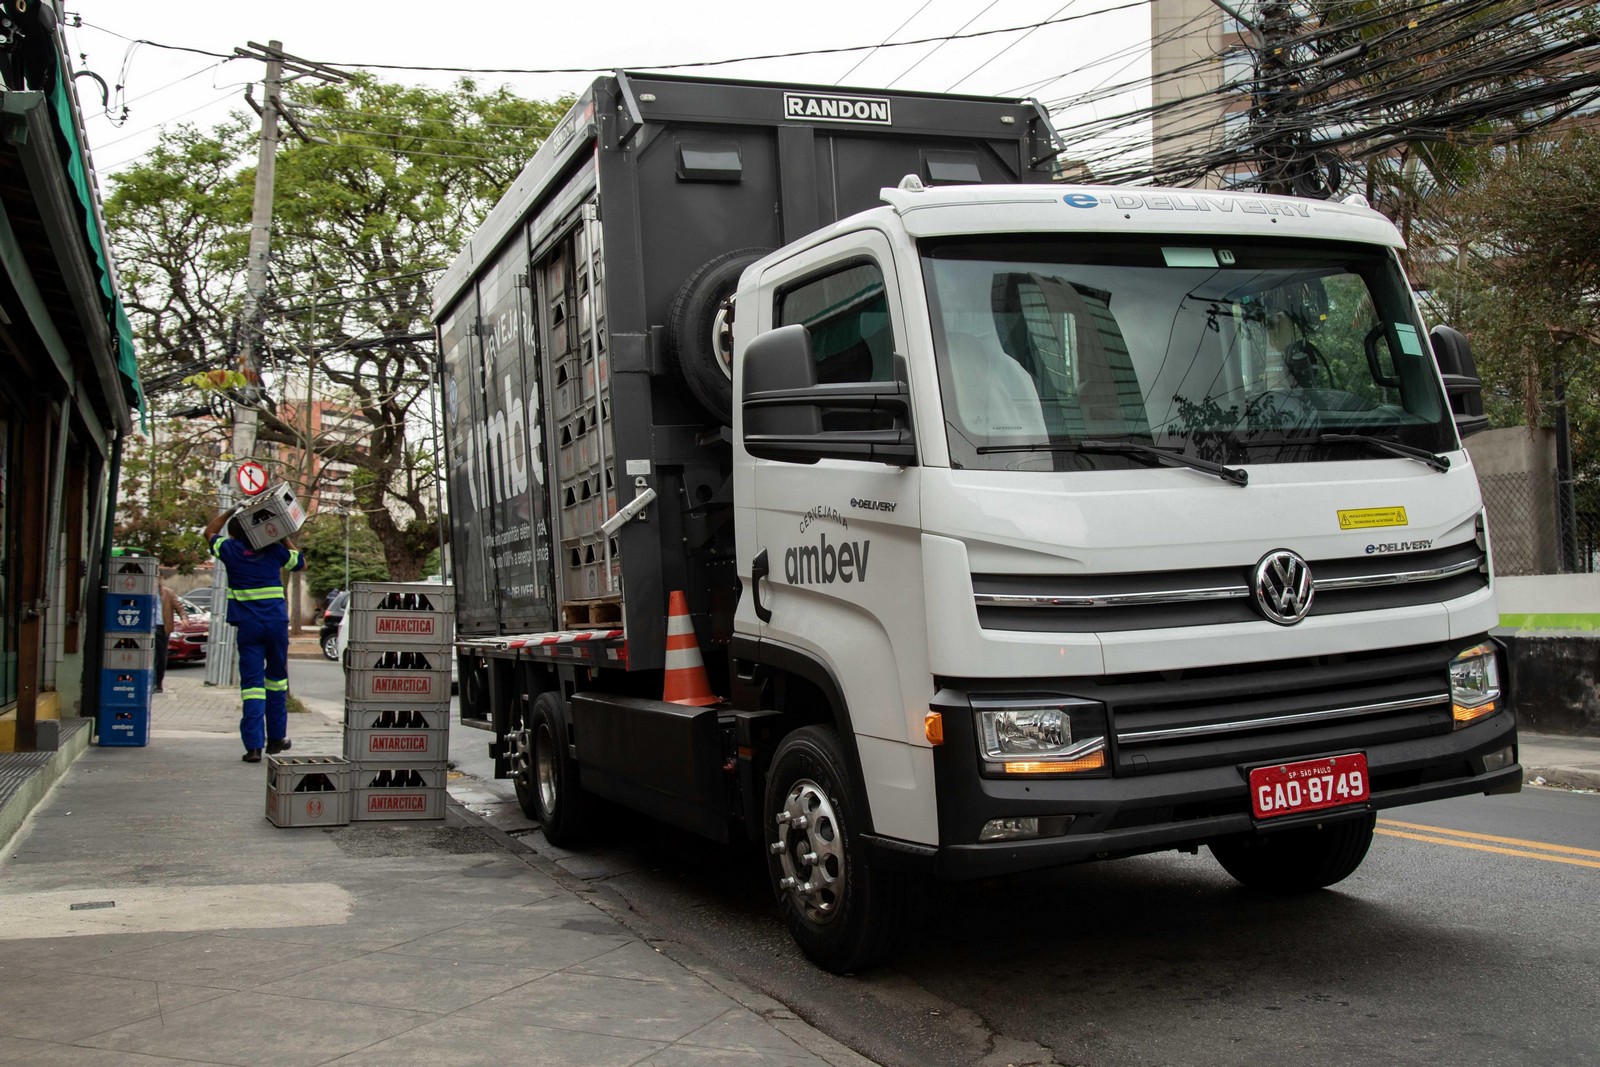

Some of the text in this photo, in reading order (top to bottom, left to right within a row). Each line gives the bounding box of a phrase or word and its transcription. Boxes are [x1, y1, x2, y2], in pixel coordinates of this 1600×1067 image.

[788, 97, 887, 120] RANDON
[1062, 193, 1310, 217] e-DELIVERY
[850, 497, 897, 513] e-DELIVERY
[799, 505, 848, 534] CERVEJARIA
[1365, 539, 1433, 554] e-DELIVERY
[785, 533, 870, 585] ambev
[378, 618, 431, 633] ANTARCTICA
[375, 678, 428, 692] ANTARCTICA
[372, 737, 425, 750] ANTARCTICA
[1313, 766, 1331, 775] PAULO
[370, 796, 423, 810] ANTARCTICA
